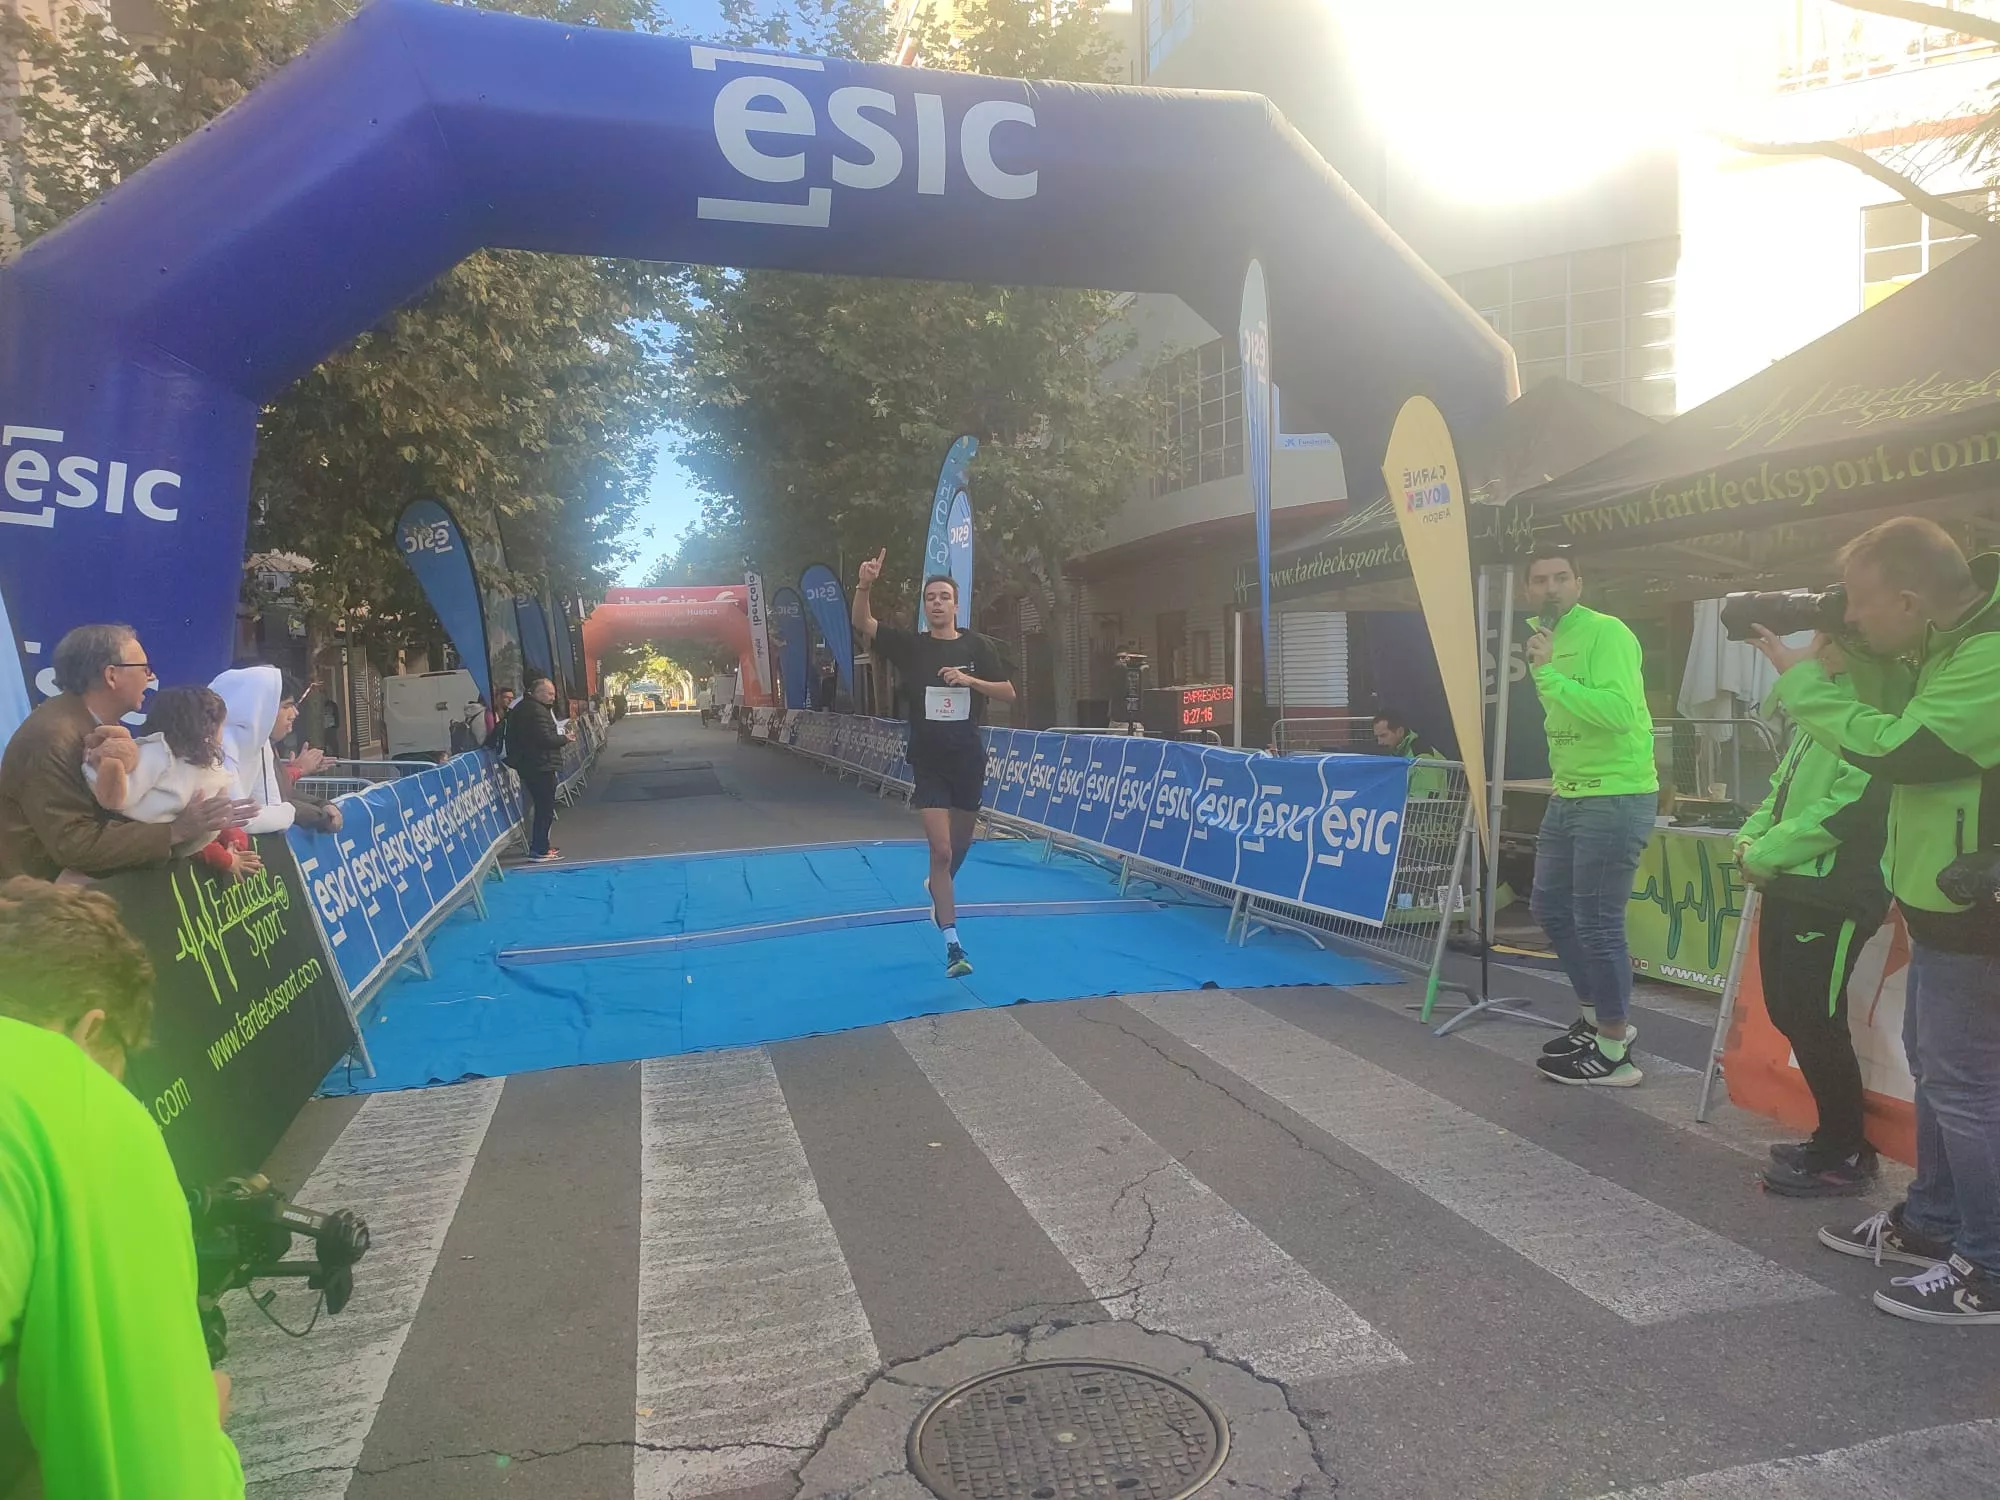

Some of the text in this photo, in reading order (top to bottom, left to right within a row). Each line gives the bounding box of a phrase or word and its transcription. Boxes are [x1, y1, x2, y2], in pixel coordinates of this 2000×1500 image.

[711, 74, 1040, 204] esic
[2, 448, 182, 523] esic
[1562, 428, 2000, 537] www.fartlecksport.com
[943, 698, 952, 708] 3
[1005, 757, 1029, 785] esic
[1028, 759, 1056, 791] esic
[1057, 767, 1085, 799] esic
[1085, 772, 1117, 804] esic
[1118, 777, 1152, 812] esic
[1155, 783, 1193, 821] esic
[1195, 792, 1247, 832] esic
[1253, 800, 1315, 842] esic
[1321, 802, 1399, 856] esic
[313, 866, 358, 924] esic
[240, 904, 288, 969] Sport
[1659, 962, 1728, 990] www.fa
